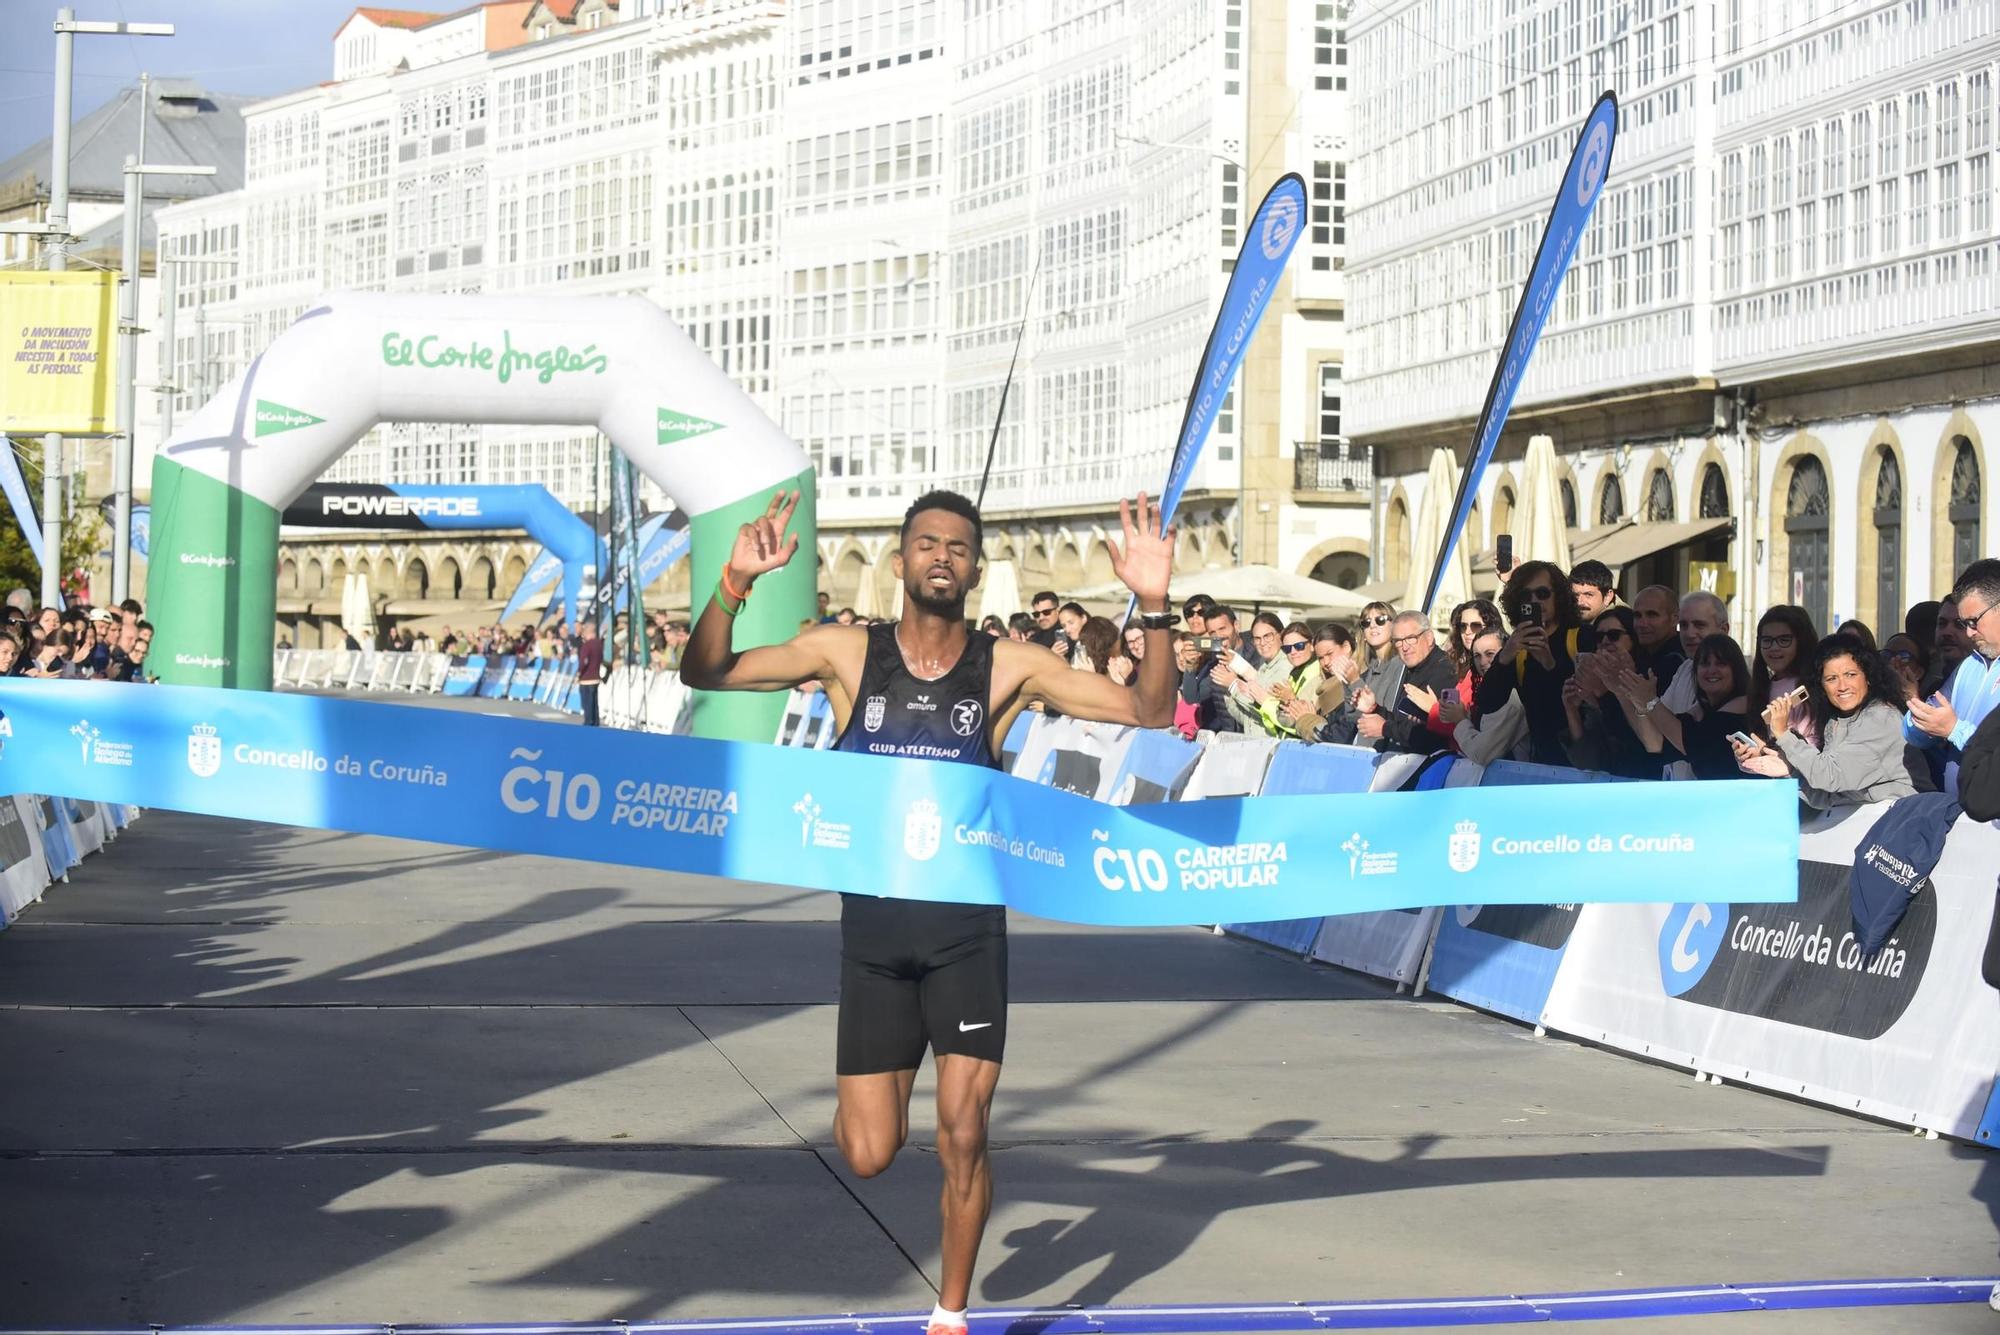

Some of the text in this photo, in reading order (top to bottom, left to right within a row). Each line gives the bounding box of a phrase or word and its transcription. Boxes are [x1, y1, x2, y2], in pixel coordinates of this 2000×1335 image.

[24, 340, 37, 350] DA
[31, 327, 92, 338] MOVEMENTO
[1212, 360, 1229, 388] da
[1227, 277, 1267, 355] Coruña
[1518, 321, 1534, 357] da
[15, 351, 99, 362] NECESITA A TODAS
[27, 363, 41, 374] AS
[382, 329, 607, 384] El Corte Inglés
[906, 702, 937, 711] amura
[869, 743, 961, 758] CLUB ATLETISMO
[234, 744, 447, 786] Concello da Coruña
[615, 780, 738, 814] CARREIRA
[611, 803, 728, 837] POPULAR
[1010, 835, 1025, 857] da
[1026, 840, 1066, 868] Coruña
[1174, 841, 1288, 869] CARREIRA
[1491, 830, 1695, 856] Concello da Coruña
[1180, 863, 1281, 890] POPULAR
[1730, 914, 1803, 960] Concello
[1803, 924, 1832, 966] da
